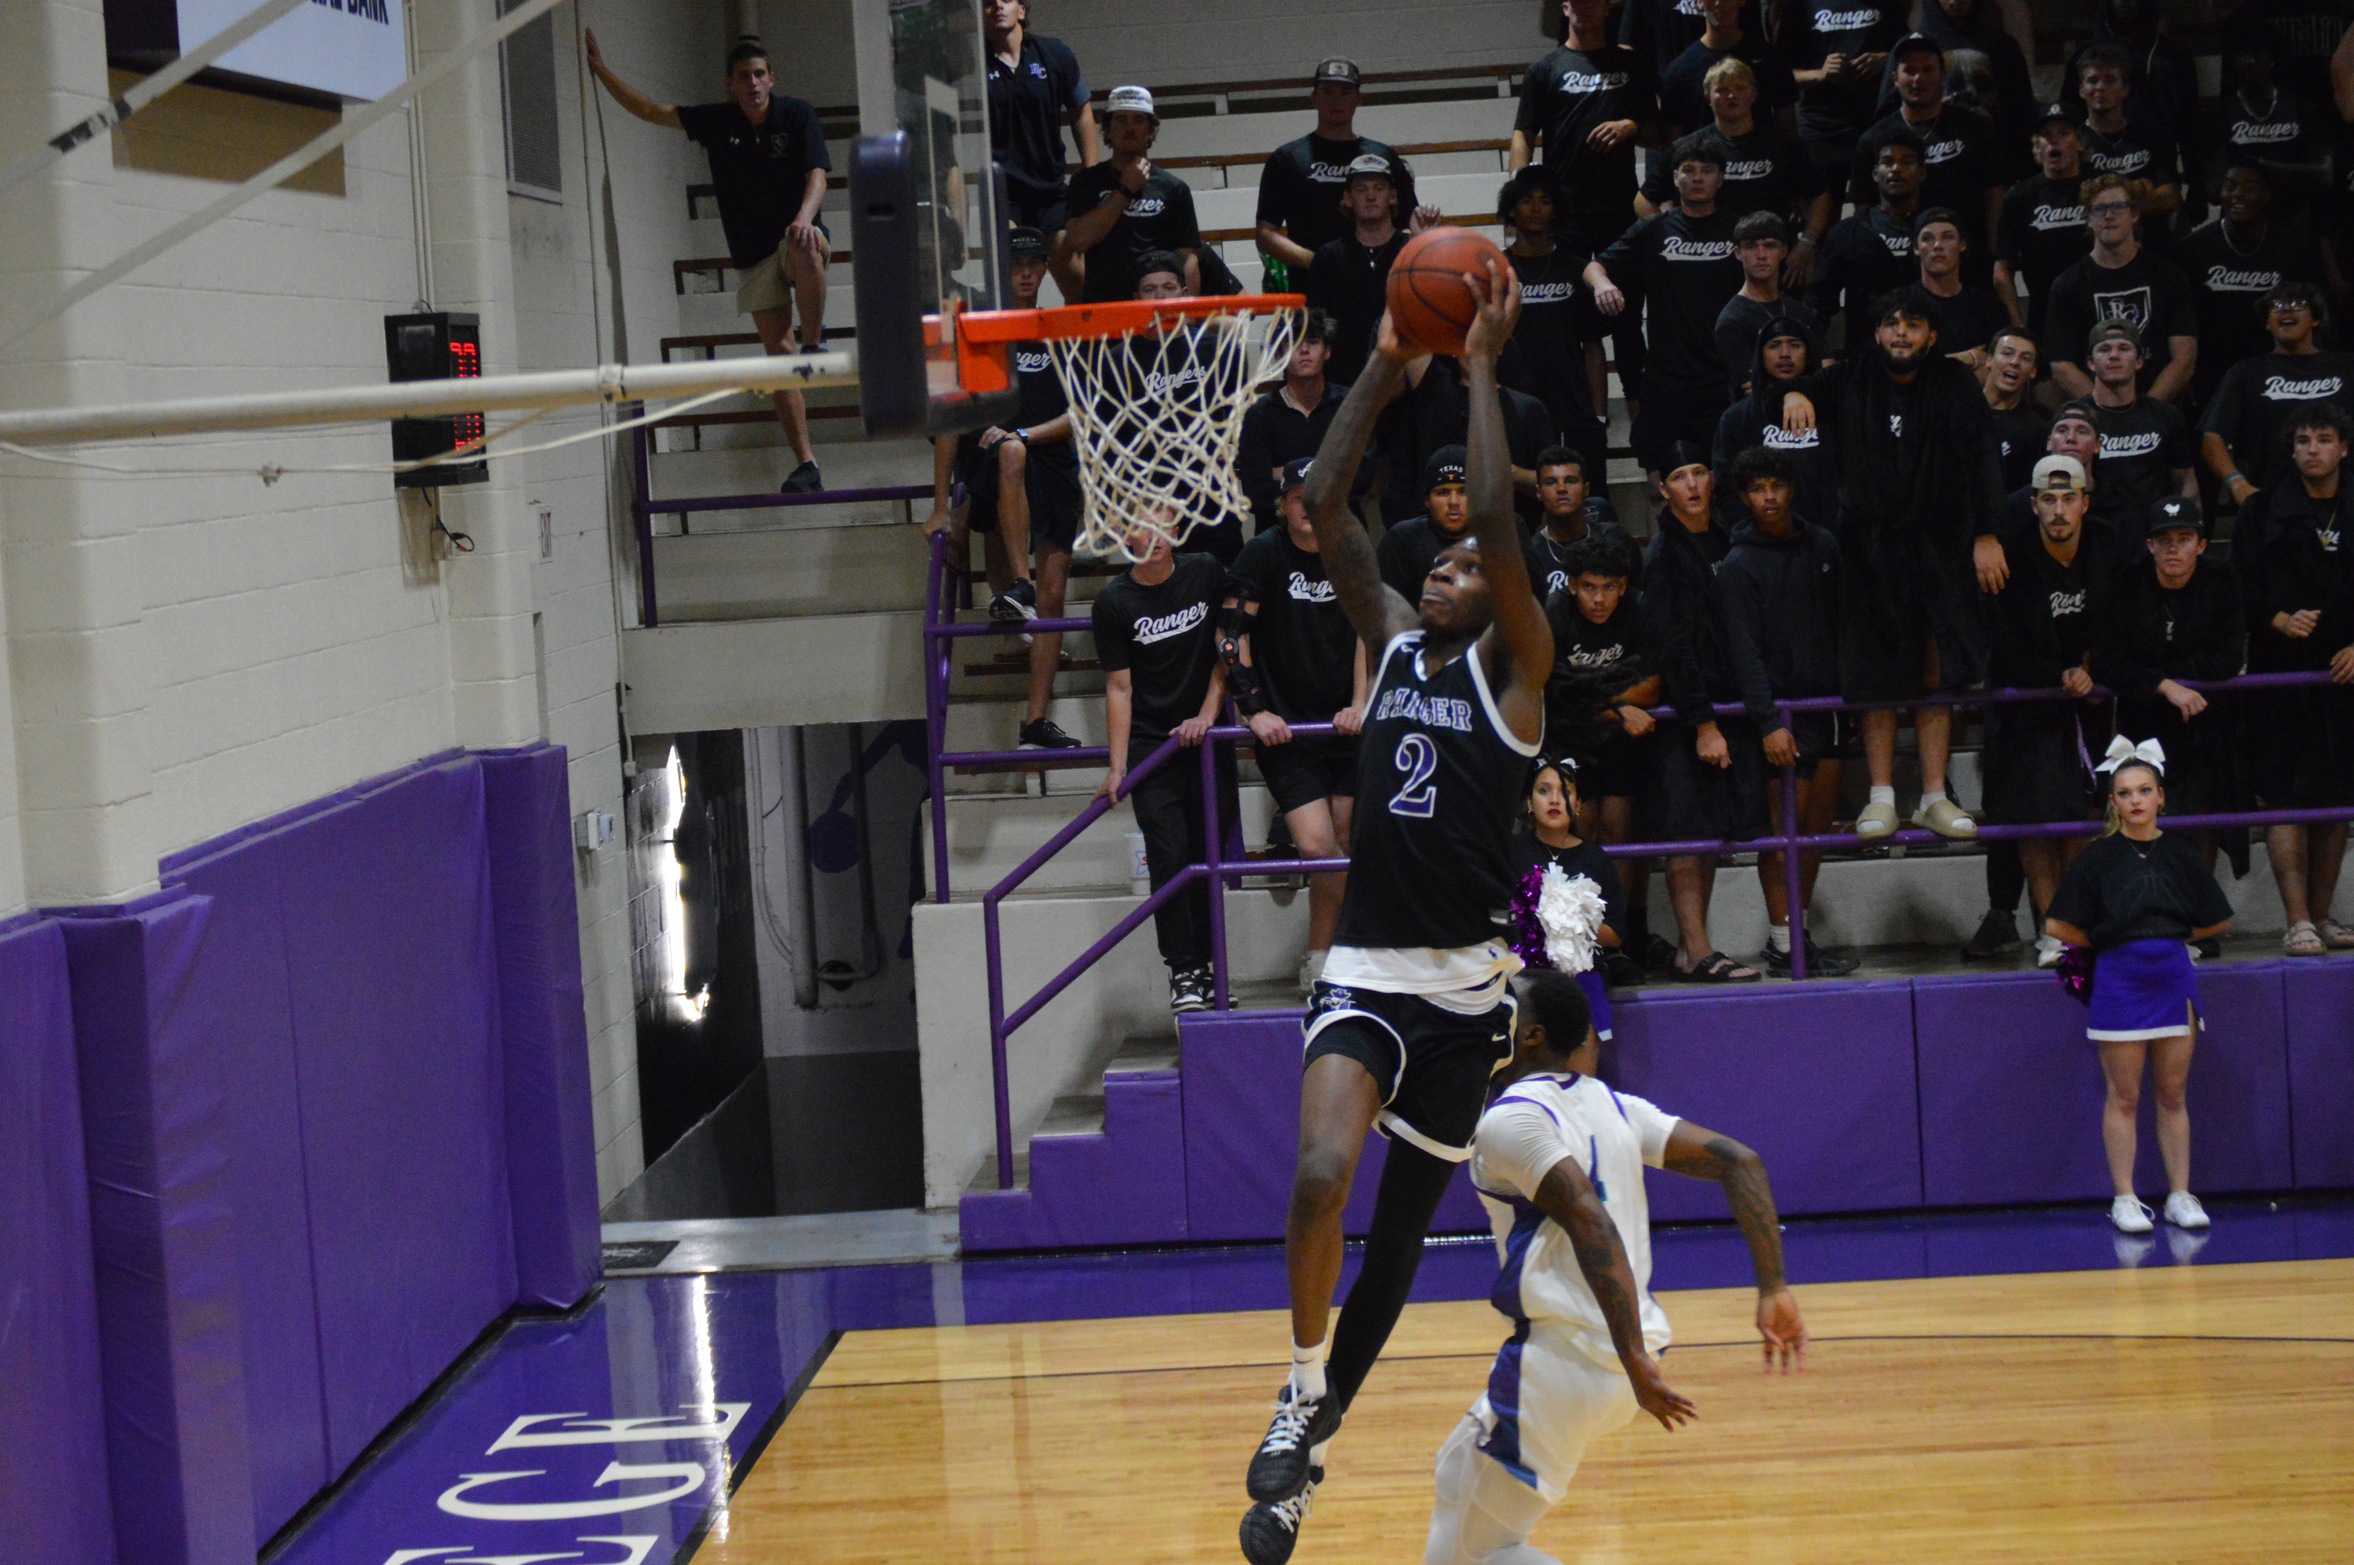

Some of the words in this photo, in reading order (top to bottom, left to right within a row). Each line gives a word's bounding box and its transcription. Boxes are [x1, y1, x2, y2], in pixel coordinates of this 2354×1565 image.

[1811, 8, 1882, 32] Ranger
[1559, 71, 1630, 94] Ranger
[2229, 121, 2299, 145] Ranger
[1307, 162, 1345, 183] Ran
[2091, 149, 2150, 174] Ranger
[2028, 204, 2086, 231] Rang
[1659, 236, 1734, 261] Ranger
[2203, 265, 2281, 292] Ranger
[2260, 376, 2343, 400] Ranger
[1439, 465, 1464, 474] TEXAS
[1132, 601, 1209, 646] Ranger
[1388, 732, 1437, 818] 2
